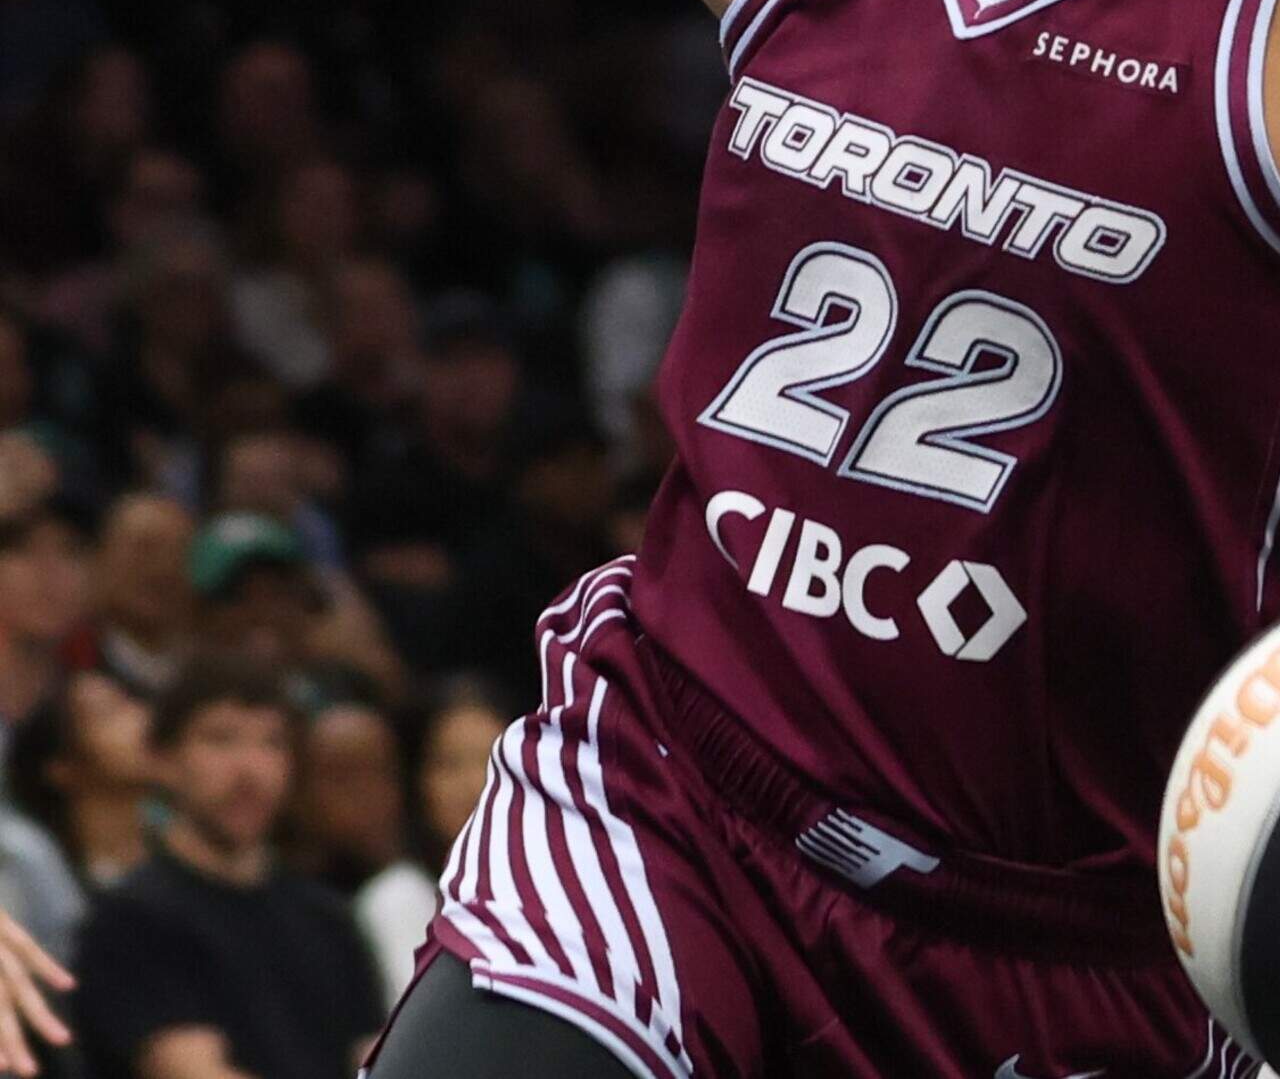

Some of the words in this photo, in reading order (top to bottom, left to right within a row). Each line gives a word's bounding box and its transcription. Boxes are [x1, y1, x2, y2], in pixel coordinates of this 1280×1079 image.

[1032, 31, 1178, 93] SEPHORA
[727, 76, 1167, 284] TORONTO
[696, 240, 1063, 515] 22
[705, 490, 911, 641] CIBC
